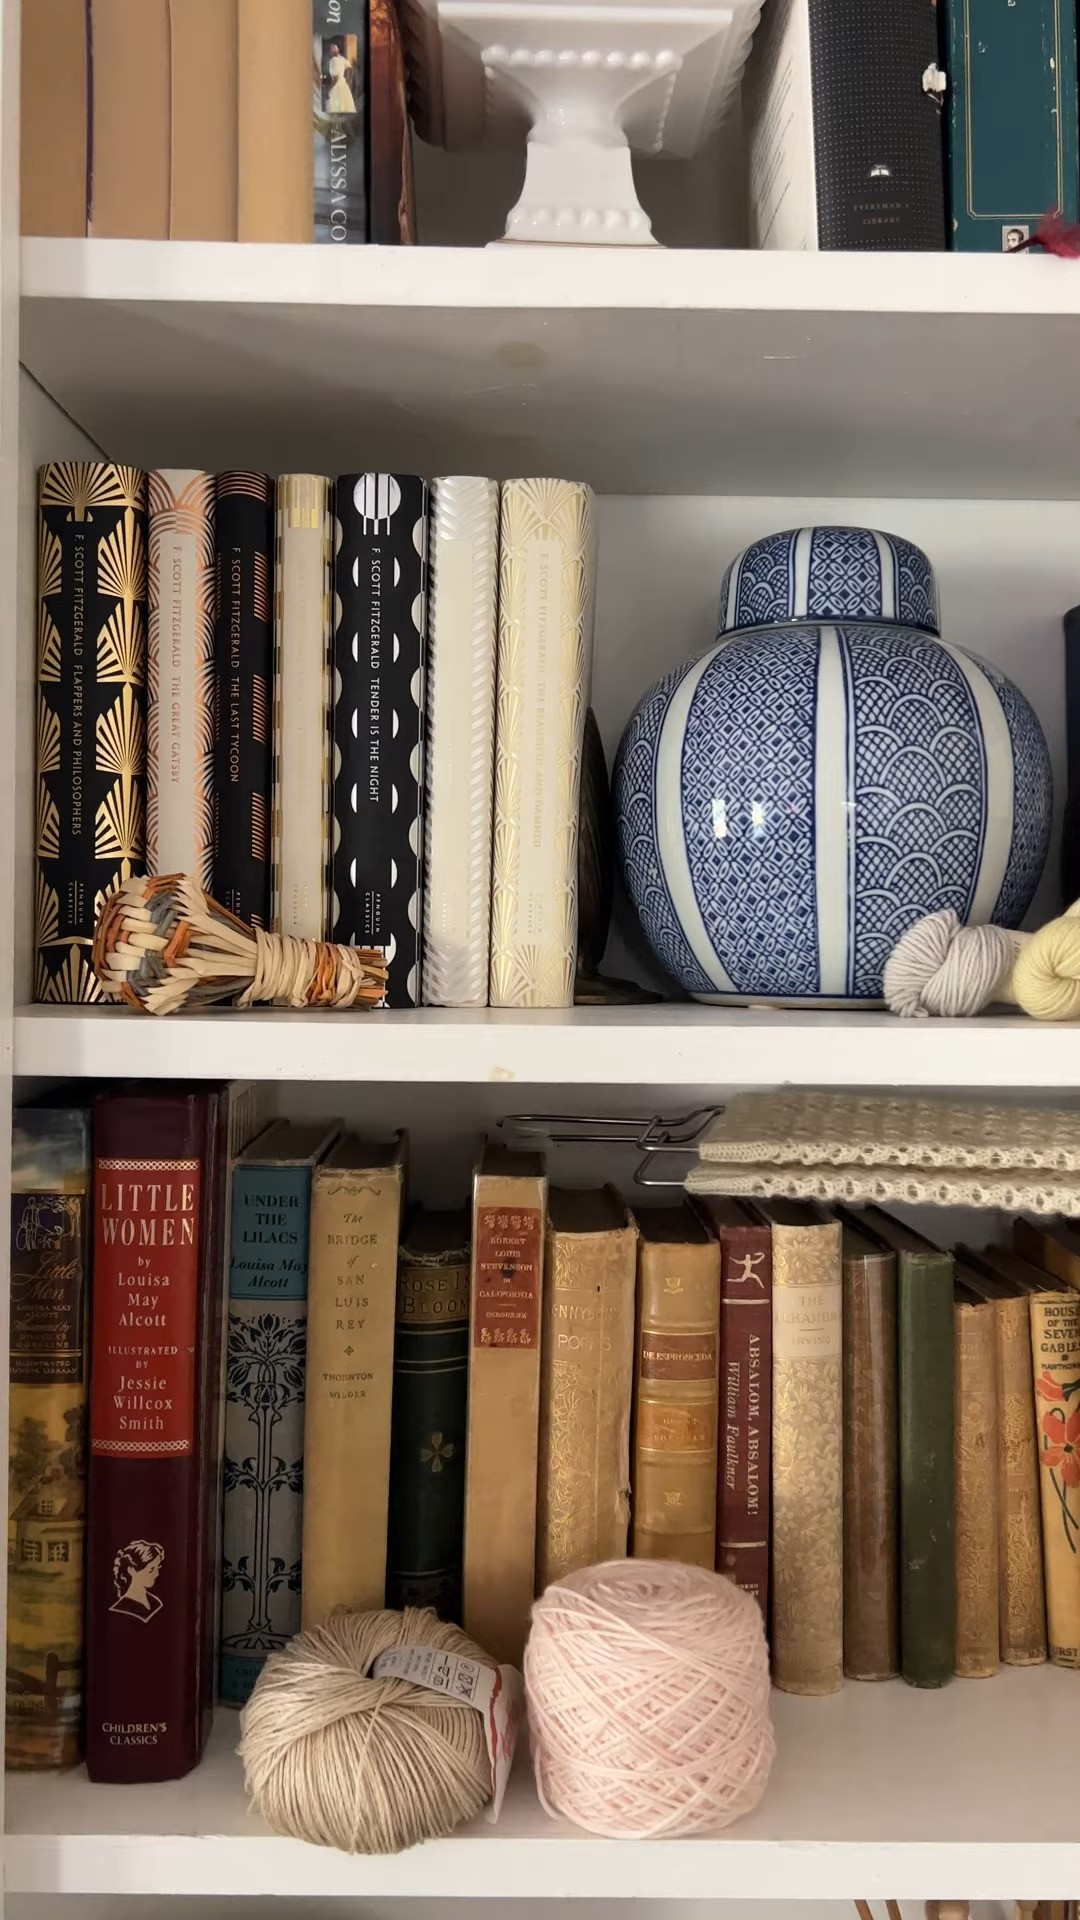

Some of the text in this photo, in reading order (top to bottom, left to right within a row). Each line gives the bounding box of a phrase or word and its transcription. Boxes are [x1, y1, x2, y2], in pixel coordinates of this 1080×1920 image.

[330, 127, 347, 204] ALYSSA
[863, 216, 900, 225] LIBRARY
[172, 558, 182, 595] SCOTT
[231, 559, 241, 596] SCOTT
[171, 600, 182, 668] FITZGERALD
[230, 600, 240, 668] FITZGERALD
[369, 547, 381, 802] F. SCOTT FITZGERALD TENDER IS THE NIGHT
[71, 534, 84, 835] F. SCOTT FITZGERALD FLAPPERS AND PHILOSOPHERS
[171, 676, 181, 698] THE
[230, 677, 240, 697] THE
[171, 703, 181, 738] GREAT
[230, 702, 239, 729] LAST
[171, 742, 181, 784] GATSBY
[229, 733, 239, 782] TYCOON
[101, 1183, 195, 1212] LITTLE
[244, 1194, 300, 1208] UNDER
[255, 1213, 287, 1226] THE
[343, 1213, 363, 1224] The
[102, 1217, 195, 1246] WOMEN
[243, 1231, 298, 1244] LILACS
[327, 1234, 378, 1246] BRIDGE
[495, 1250, 521, 1258] LOUIS
[138, 1256, 151, 1268] by
[229, 1256, 308, 1275] Louisa May
[346, 1255, 360, 1268] of
[480, 1263, 533, 1271] STEVENSON
[118, 1272, 170, 1287] Louisa
[248, 1275, 289, 1288] Alcott
[337, 1274, 365, 1286] SAN
[401, 1273, 448, 1293] ROSE
[128, 1292, 159, 1311] May
[335, 1296, 369, 1308] LUIS
[479, 1291, 534, 1299] CALIFORNIA
[799, 1295, 825, 1307] THE
[402, 1296, 470, 1315] BLOOM
[118, 1312, 167, 1327] Alcott
[336, 1319, 366, 1330] REY
[1047, 1319, 1080, 1327] OF THE
[108, 1345, 178, 1356] ILLUSTRATED
[643, 1350, 713, 1361] DE ESPRONCEDA
[135, 1360, 149, 1369] BY
[118, 1376, 167, 1393] Jessie
[322, 1373, 374, 1382] THORNTON
[329, 1390, 367, 1399] WILDER
[113, 1395, 173, 1410] Willcox
[119, 1416, 164, 1430] Smith
[725, 1361, 741, 1490] William Faulkner
[747, 1333, 761, 1516] ABSALOM, ABSALOM!
[101, 1722, 168, 1735] CHILDREN'S
[109, 1735, 158, 1746] CLASSICS
